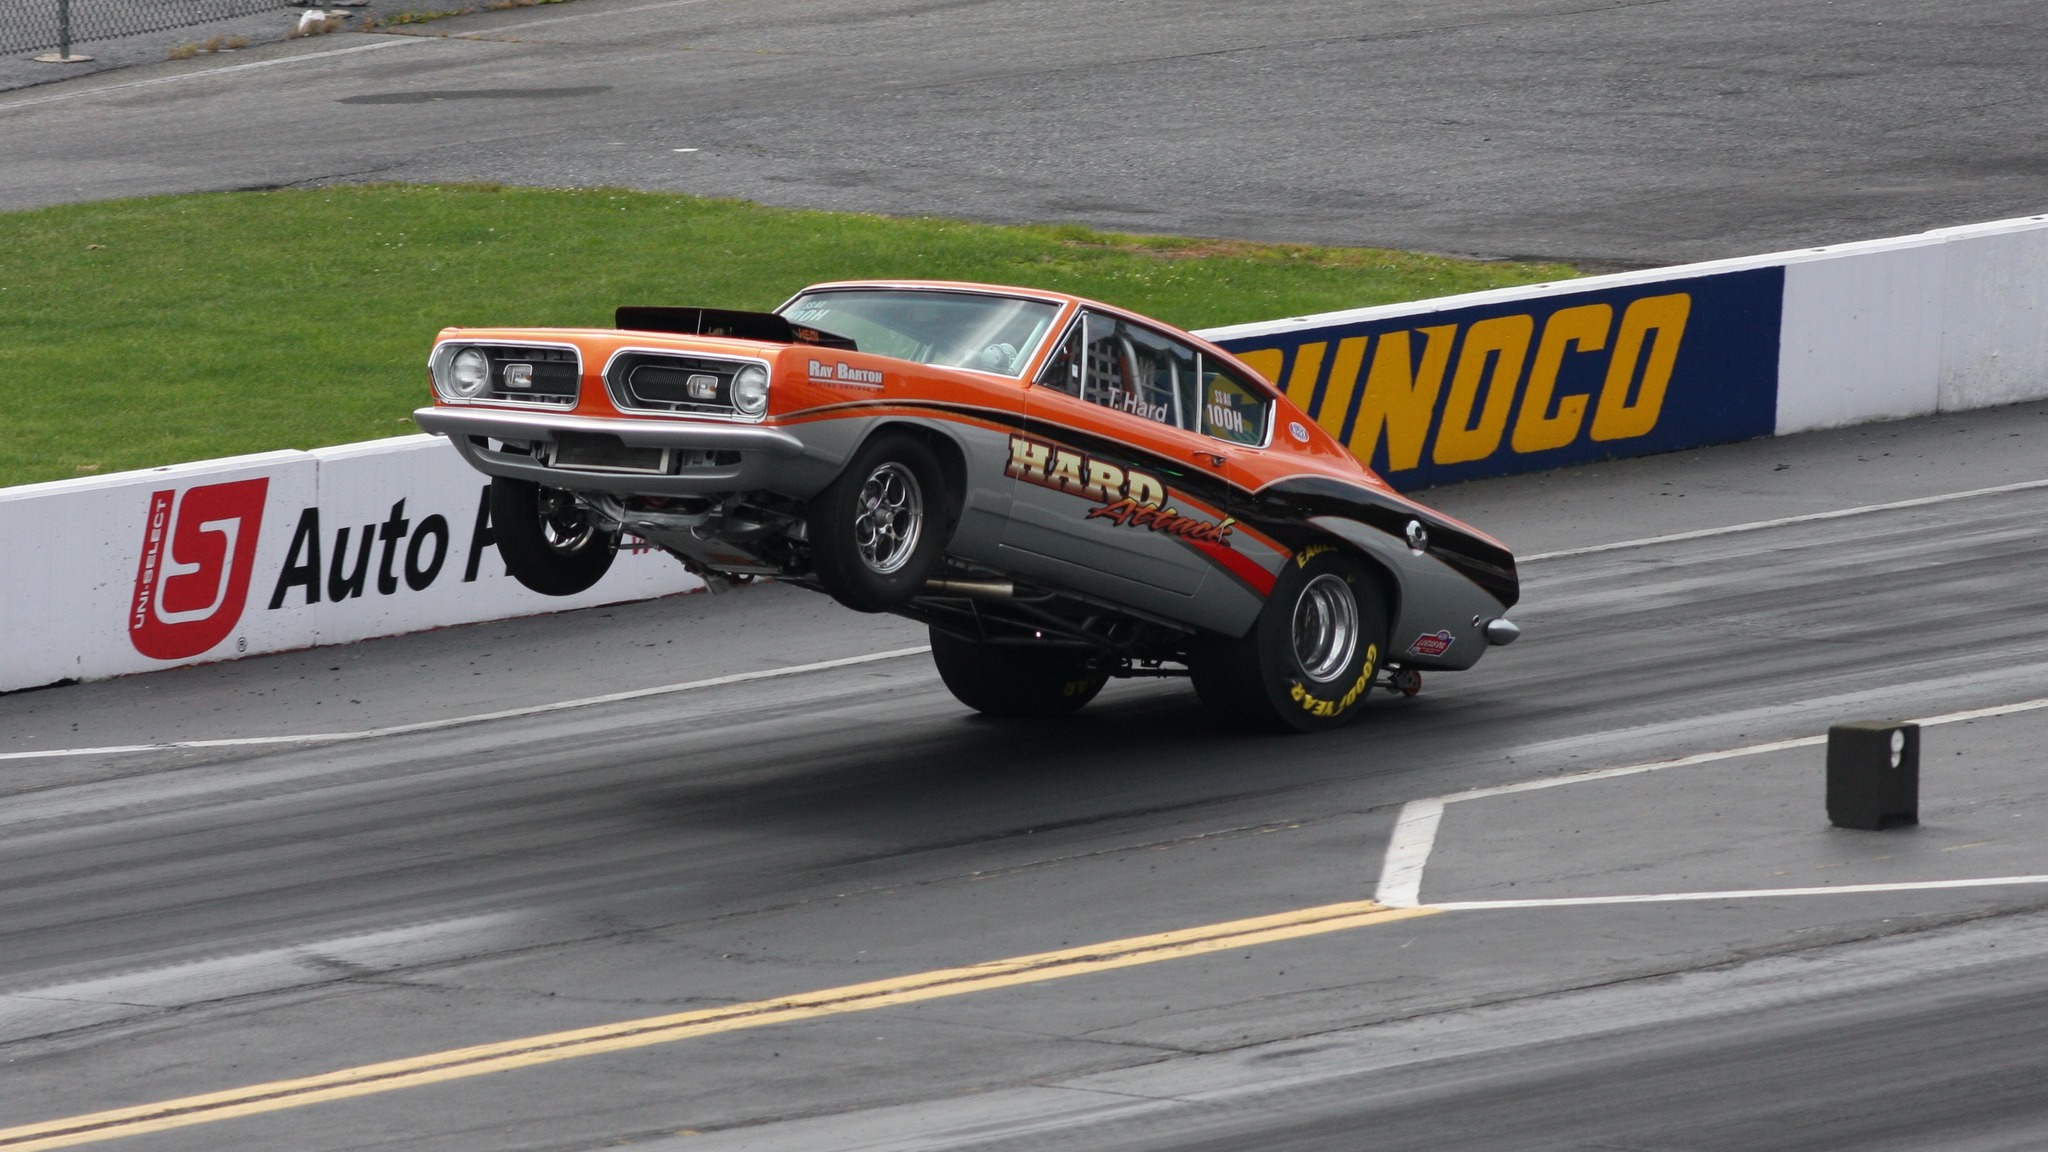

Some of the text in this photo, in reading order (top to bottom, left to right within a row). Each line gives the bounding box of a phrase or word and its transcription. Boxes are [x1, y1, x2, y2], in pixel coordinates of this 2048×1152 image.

[808, 359, 883, 384] RAY BARTON
[1123, 391, 1168, 423] Hard
[1207, 403, 1243, 434] 100H
[1006, 435, 1167, 509] HARD
[1086, 497, 1235, 547] Attack
[134, 499, 167, 629] UNI-SELECT
[268, 497, 449, 610] Auto
